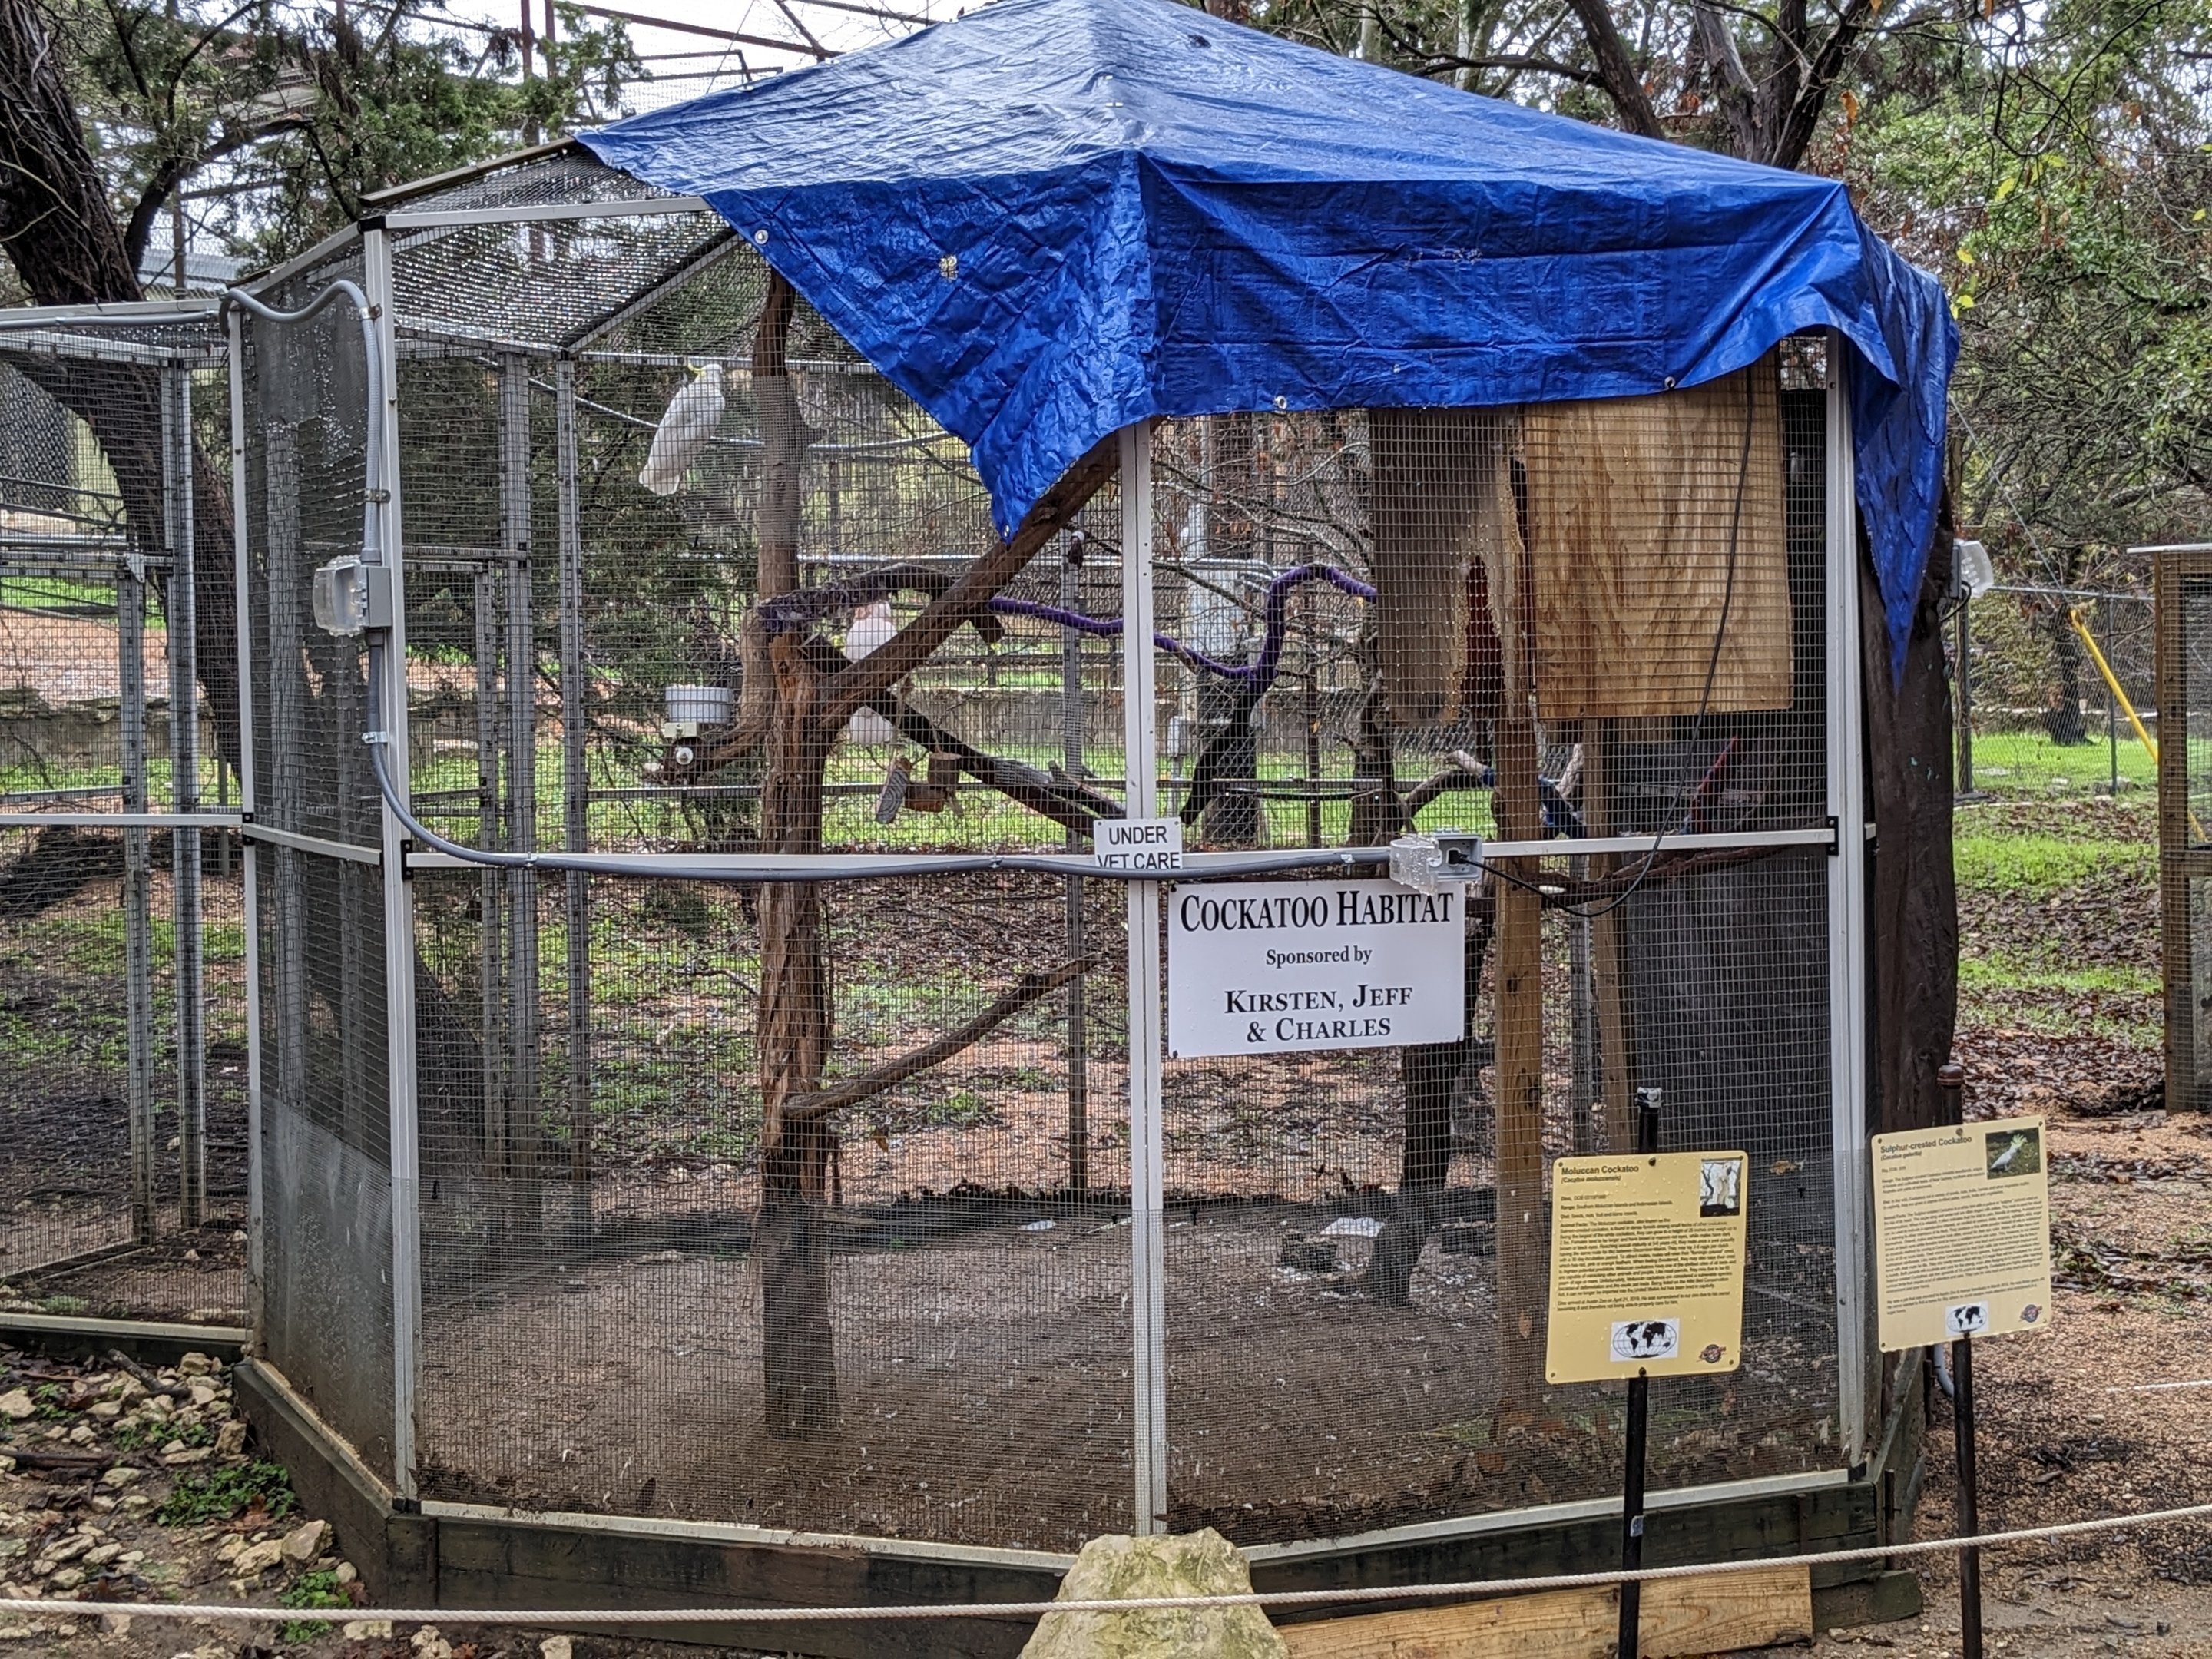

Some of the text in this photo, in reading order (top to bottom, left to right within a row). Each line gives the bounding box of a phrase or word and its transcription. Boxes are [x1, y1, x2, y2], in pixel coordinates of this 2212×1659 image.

[1109, 826, 1168, 846] UNDER
[1097, 852, 1181, 869] VET CARE
[1181, 890, 1454, 932] COCKATOO HABITAT
[1267, 945, 1373, 968] Sponsored by
[1224, 985, 1412, 1014] KIRSTEN, JEFF
[1247, 1018, 1391, 1043] & CHARLES
[1880, 1137, 1972, 1153] Sulphur-crested Cockatoo
[1561, 1165, 1639, 1175] Moluccan Cockatoo
